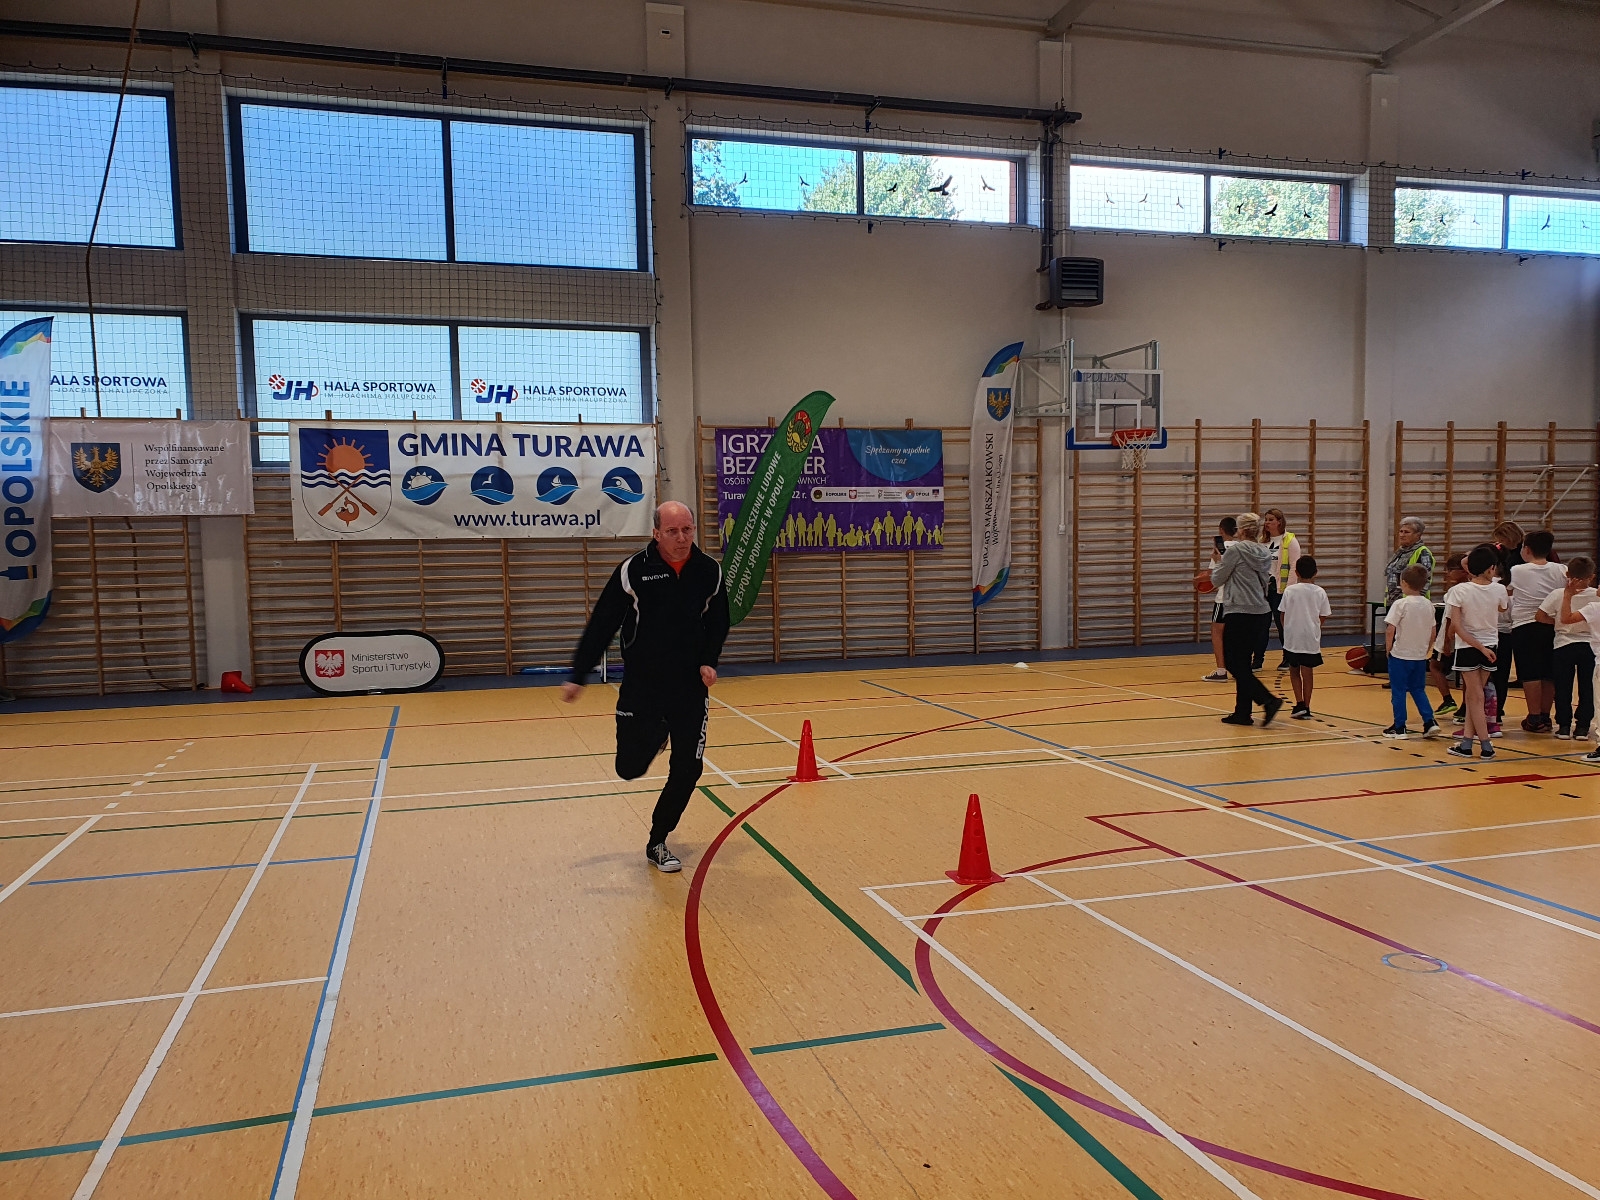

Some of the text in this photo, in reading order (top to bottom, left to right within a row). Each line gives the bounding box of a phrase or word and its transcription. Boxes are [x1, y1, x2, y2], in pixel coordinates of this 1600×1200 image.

[50, 375, 80, 386] ALA
[323, 381, 437, 393] HALA SPORTOWA
[523, 385, 628, 397] HALA SPORTOWA
[144, 443, 225, 455] Współfinansowane
[397, 432, 645, 458] GMINA TURAWA
[722, 433, 825, 454] IGRZA
[864, 444, 902, 457] Spędzamy
[145, 456, 213, 467] przez Samorząd
[722, 456, 758, 475] BEZ
[0, 380, 37, 558] OPOLSKIE
[145, 469, 207, 480] Województwa
[723, 475, 746, 486] OSÓB
[984, 433, 994, 528] MARSZAŁKOWSKI
[146, 482, 197, 493] Opolskiego
[453, 509, 601, 529] www.turawa.pl
[724, 450, 782, 593] EWÓDZKIE ZRZESZENIE LUDOWE
[733, 474, 785, 607] ZESPOŁY SPORTOWE W OPOLU
[351, 652, 409, 662] Ministerstwo
[352, 664, 384, 675] Sportu
[390, 661, 432, 673] Turystyki
